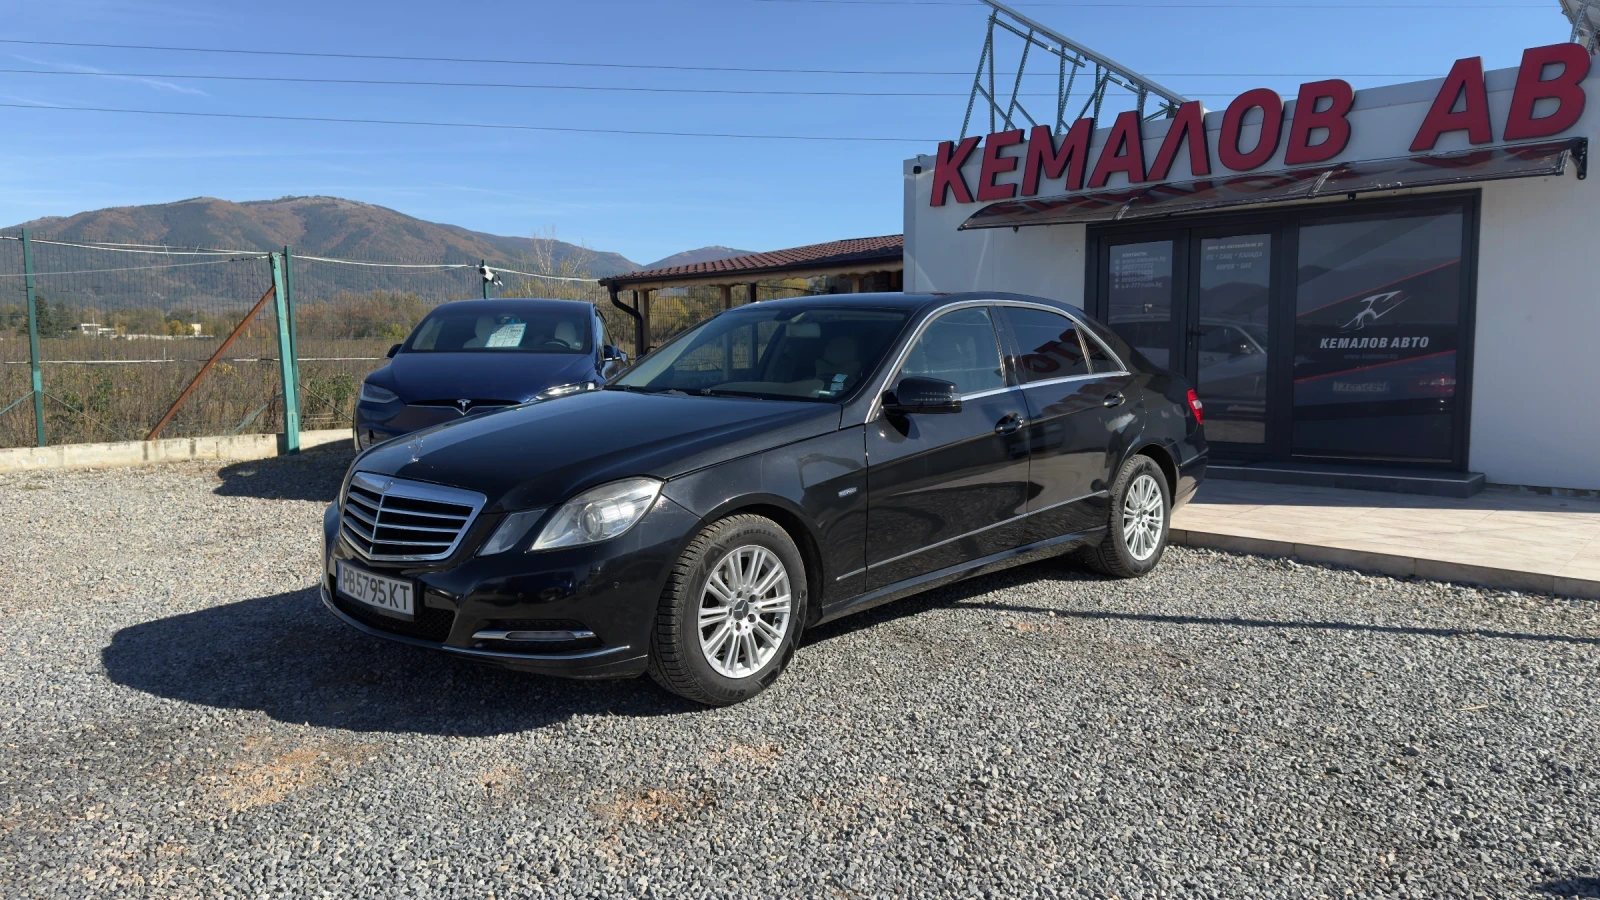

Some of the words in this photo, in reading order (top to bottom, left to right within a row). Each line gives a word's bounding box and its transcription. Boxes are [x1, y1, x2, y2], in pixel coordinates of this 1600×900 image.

[930, 78, 1355, 207] КЕМАЛОВ
[1409, 42, 1592, 152] АВ
[1319, 337, 1388, 349] КЕМАЛОВ
[1390, 336, 1429, 348] АВТО
[725, 532, 741, 544] ICE
[743, 529, 778, 540] BLAZER
